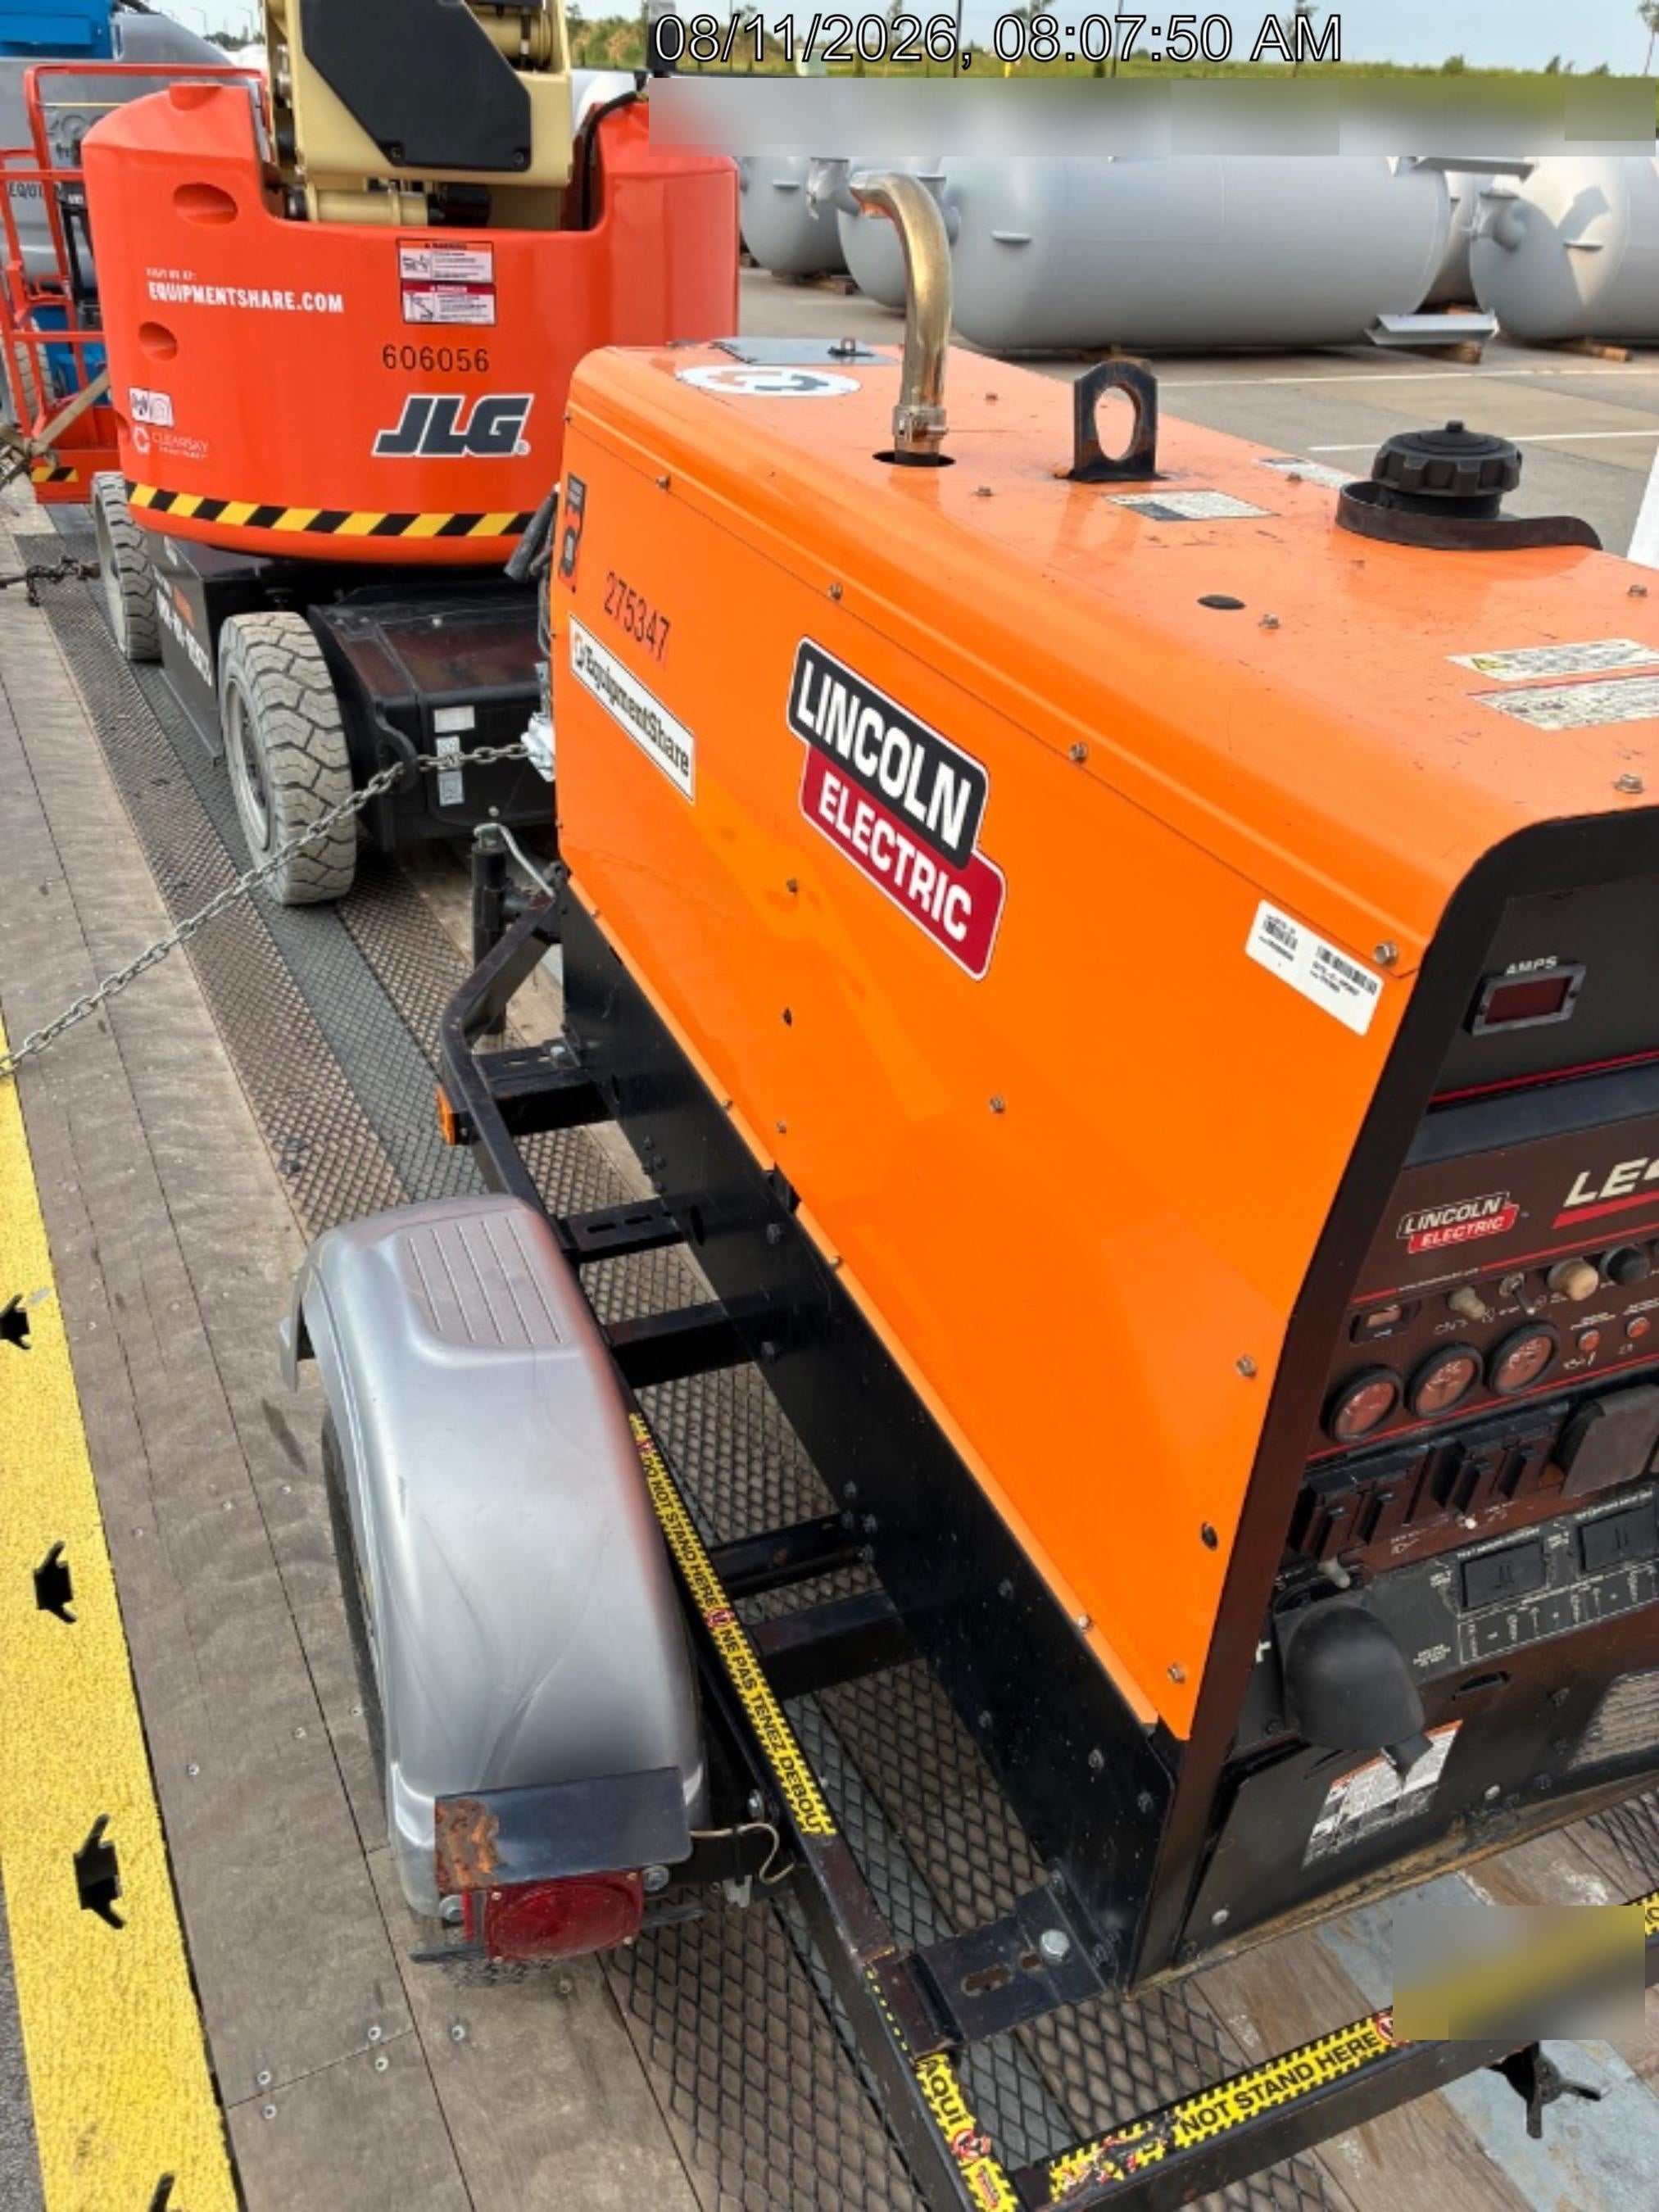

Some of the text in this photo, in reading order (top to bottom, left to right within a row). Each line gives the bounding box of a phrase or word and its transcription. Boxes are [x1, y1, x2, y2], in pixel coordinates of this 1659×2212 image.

[147, 281, 344, 314] EQUIPMENTSHARE.COM
[382, 344, 490, 373] 606056
[371, 393, 535, 458] JLG
[604, 571, 671, 661] 275347
[583, 643, 690, 778] EquipmentShare
[796, 659, 972, 849] LINCOLN
[818, 771, 973, 941] ELECTRIC
[1505, 955, 1558, 976] AMPS
[1403, 1196, 1503, 1234] LINCOLN
[1420, 1216, 1506, 1248] ELECTRIC
[664, 1512, 696, 1563] STAND
[689, 1562, 718, 1608] HERE
[718, 1628, 740, 1652] NE
[732, 1654, 758, 1693] PAS
[750, 1690, 787, 1752] TENEZ
[1180, 2031, 1380, 2137] NOT STAND HERE
